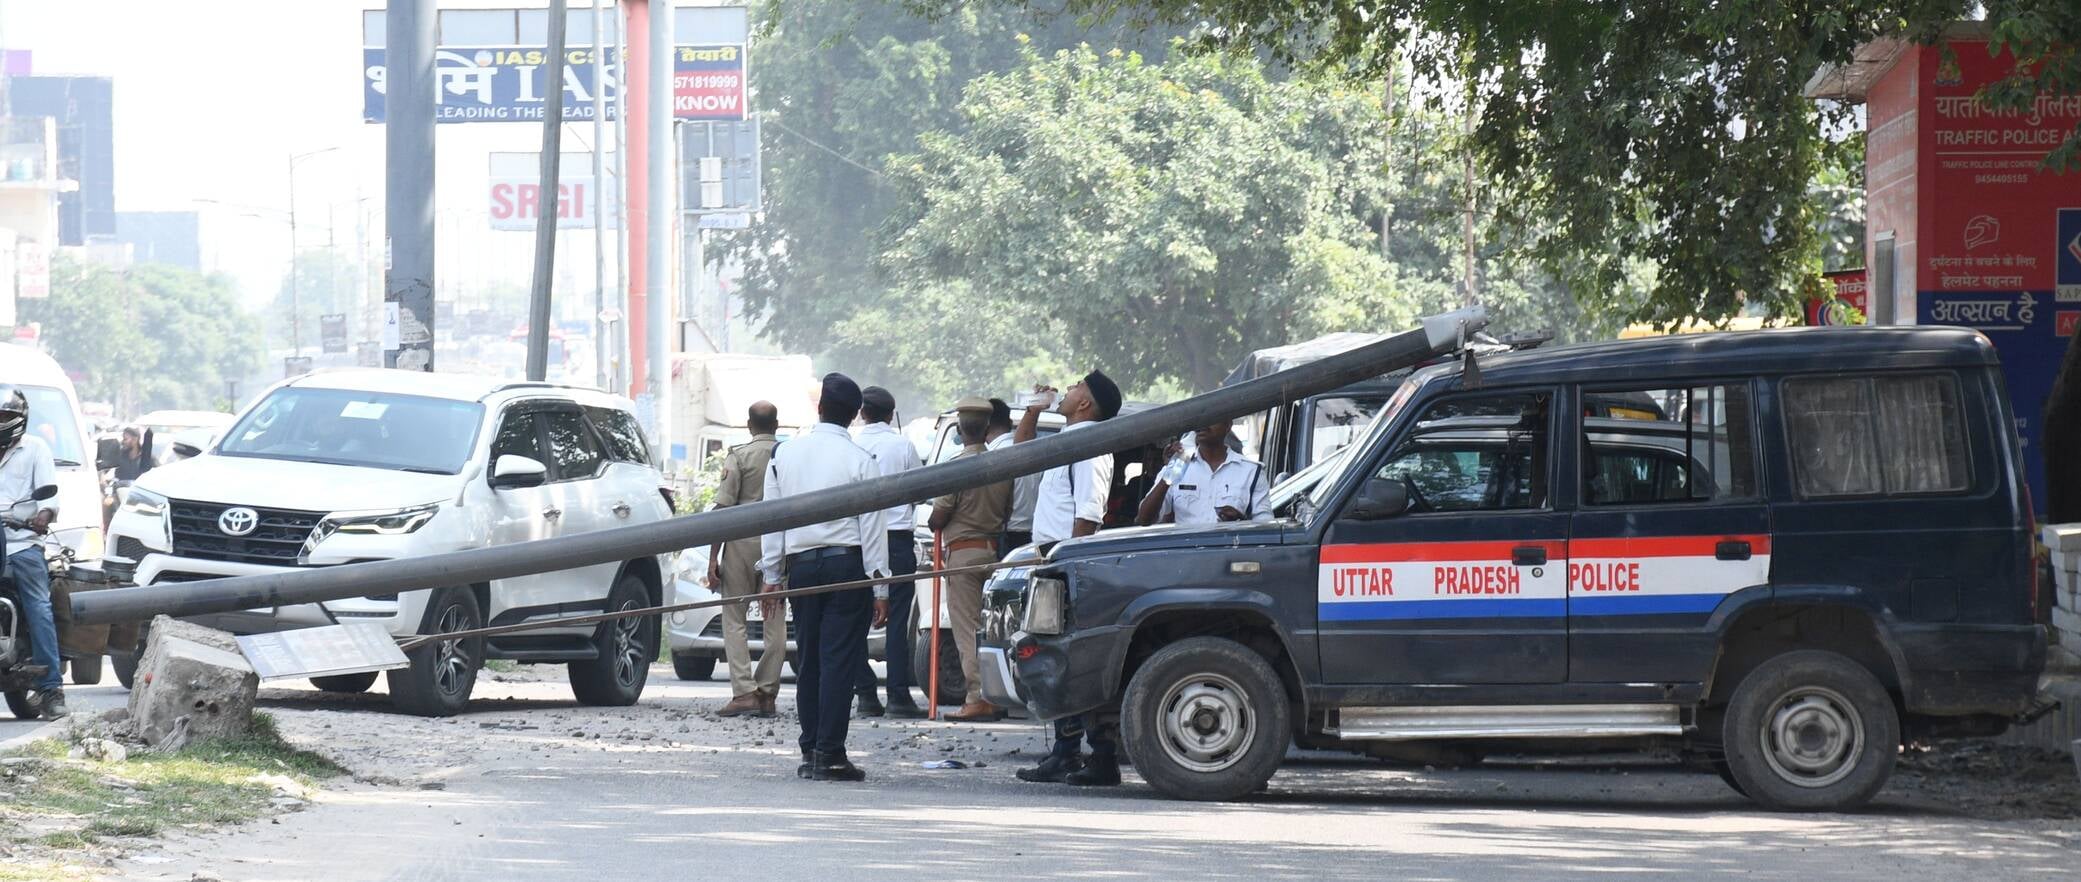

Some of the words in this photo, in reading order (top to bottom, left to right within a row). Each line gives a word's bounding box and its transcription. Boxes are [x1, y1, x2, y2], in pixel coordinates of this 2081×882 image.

[674, 75, 738, 89] 571819999
[674, 95, 738, 111] KNOW
[1935, 130, 1998, 145] TRAFFIC
[2003, 129, 2058, 145] POLICE
[1942, 160, 1968, 168] TRAFFIC
[1970, 160, 1993, 168] POLICE
[1941, 272, 1980, 288] हेलमेट
[1983, 276, 2023, 288] पहनना
[1931, 299, 2012, 322] आसान
[2017, 291, 2039, 324] है
[1333, 567, 1394, 597] UTTAR
[1434, 565, 1521, 595] PRADESH
[1569, 562, 1640, 592] POLICE
